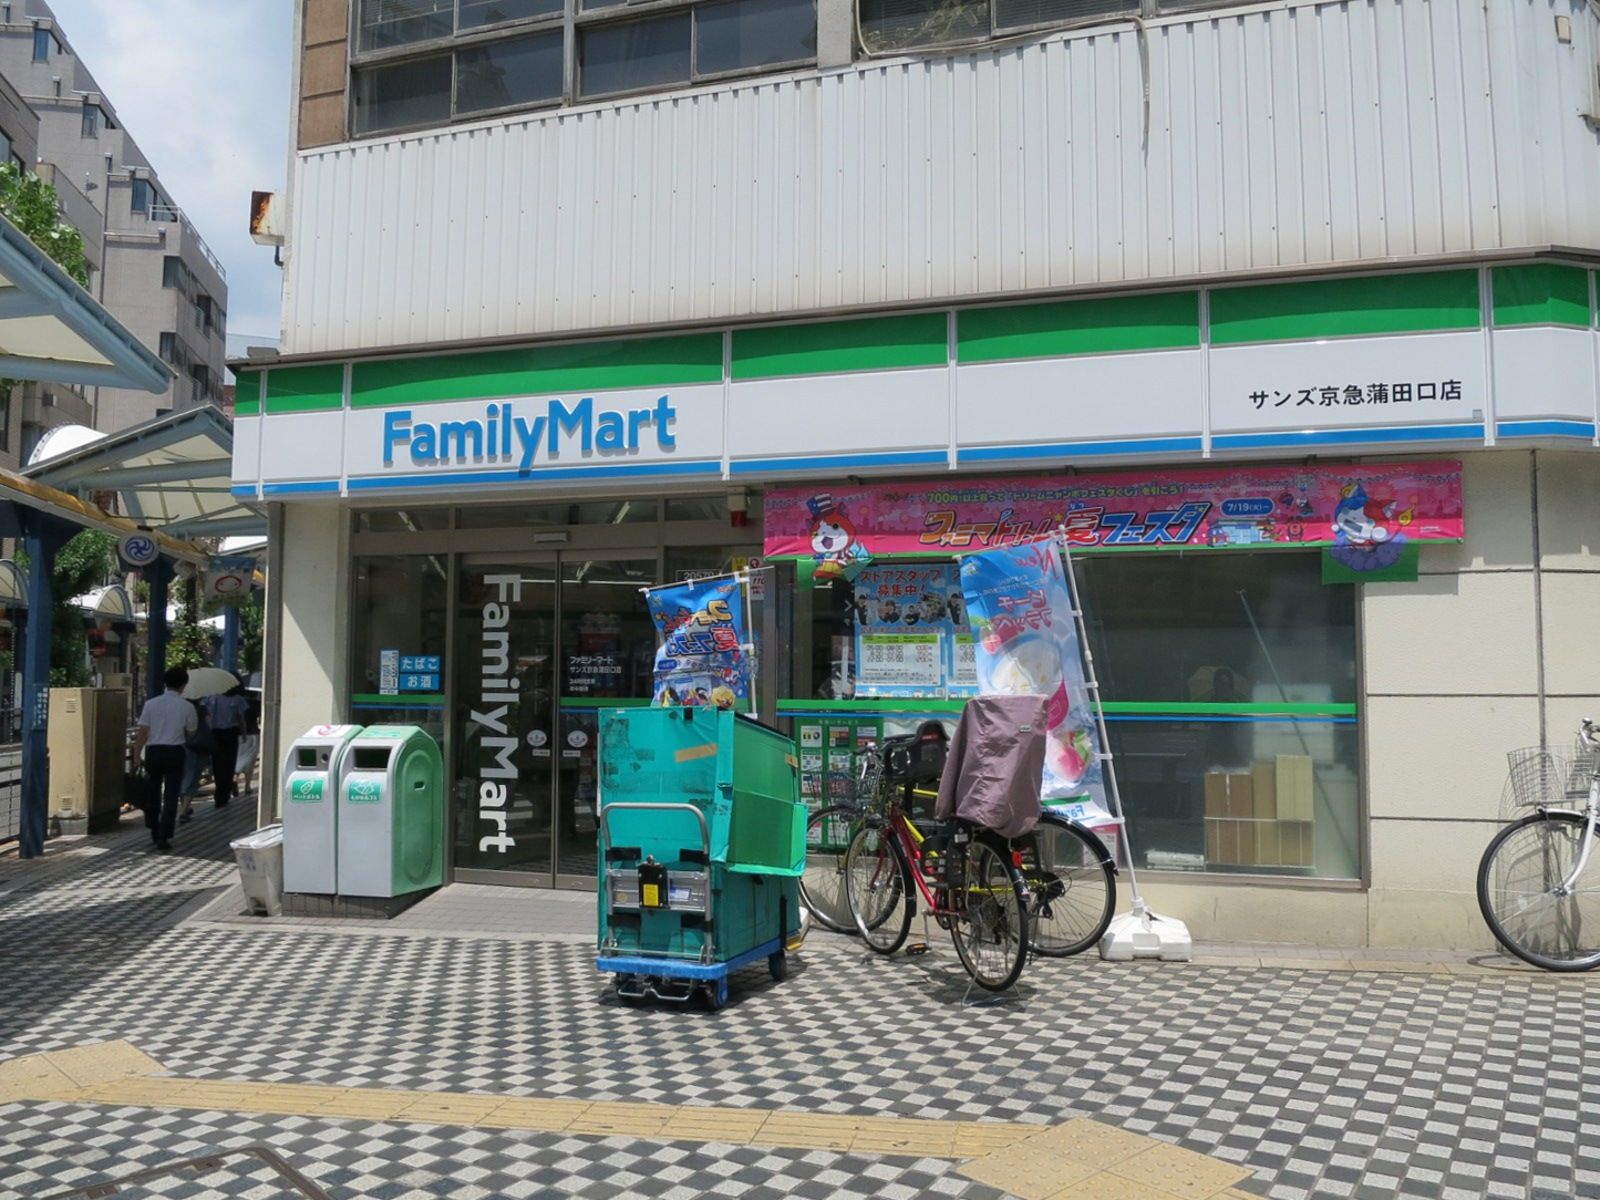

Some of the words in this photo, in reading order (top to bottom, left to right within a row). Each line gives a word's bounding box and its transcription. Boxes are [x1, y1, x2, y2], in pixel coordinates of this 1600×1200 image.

[1248, 379, 1462, 410] サンズ京急蒲田口店
[383, 394, 676, 473] FamilyMart
[861, 569, 941, 583] ストアスタッフ
[877, 584, 926, 597] 募集中!
[401, 657, 438, 670] たばこ
[569, 655, 614, 665] ファミリーマート
[407, 674, 432, 689] お酒
[470, 573, 521, 854] FamilyMart
